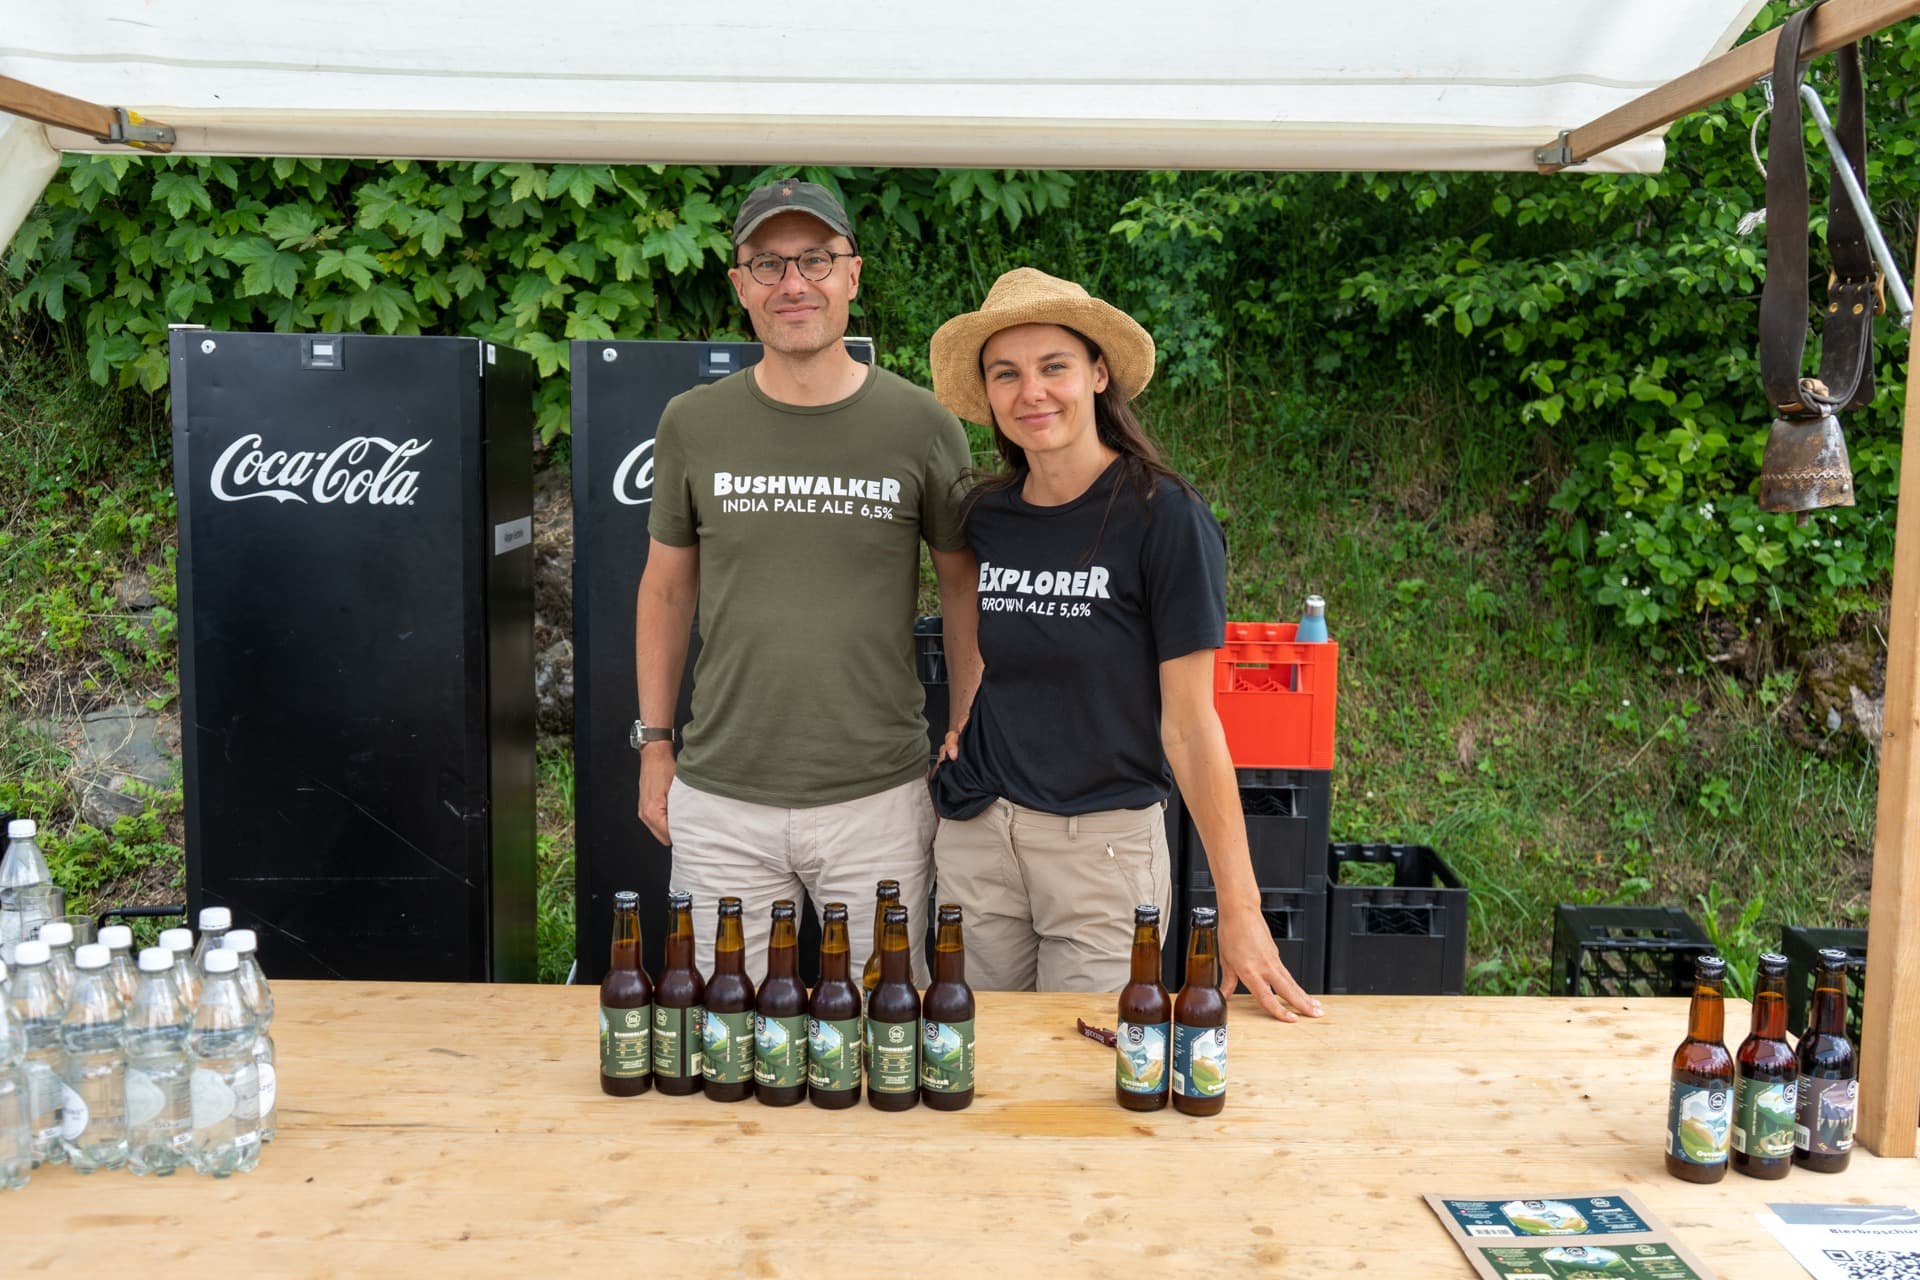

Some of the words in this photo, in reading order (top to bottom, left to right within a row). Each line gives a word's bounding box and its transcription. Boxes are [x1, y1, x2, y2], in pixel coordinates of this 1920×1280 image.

[209, 432, 432, 506] Coca-Cola
[713, 471, 902, 504] BUSHWALKER
[722, 498, 769, 513] INDIA
[774, 498, 818, 513] PALE
[821, 500, 854, 515] ALE
[860, 505, 894, 520] 6,5%
[977, 561, 1111, 599] EXPLORER
[981, 597, 1024, 613] BROWN
[1025, 600, 1057, 616] ALE
[1059, 602, 1092, 619] 5,6%
